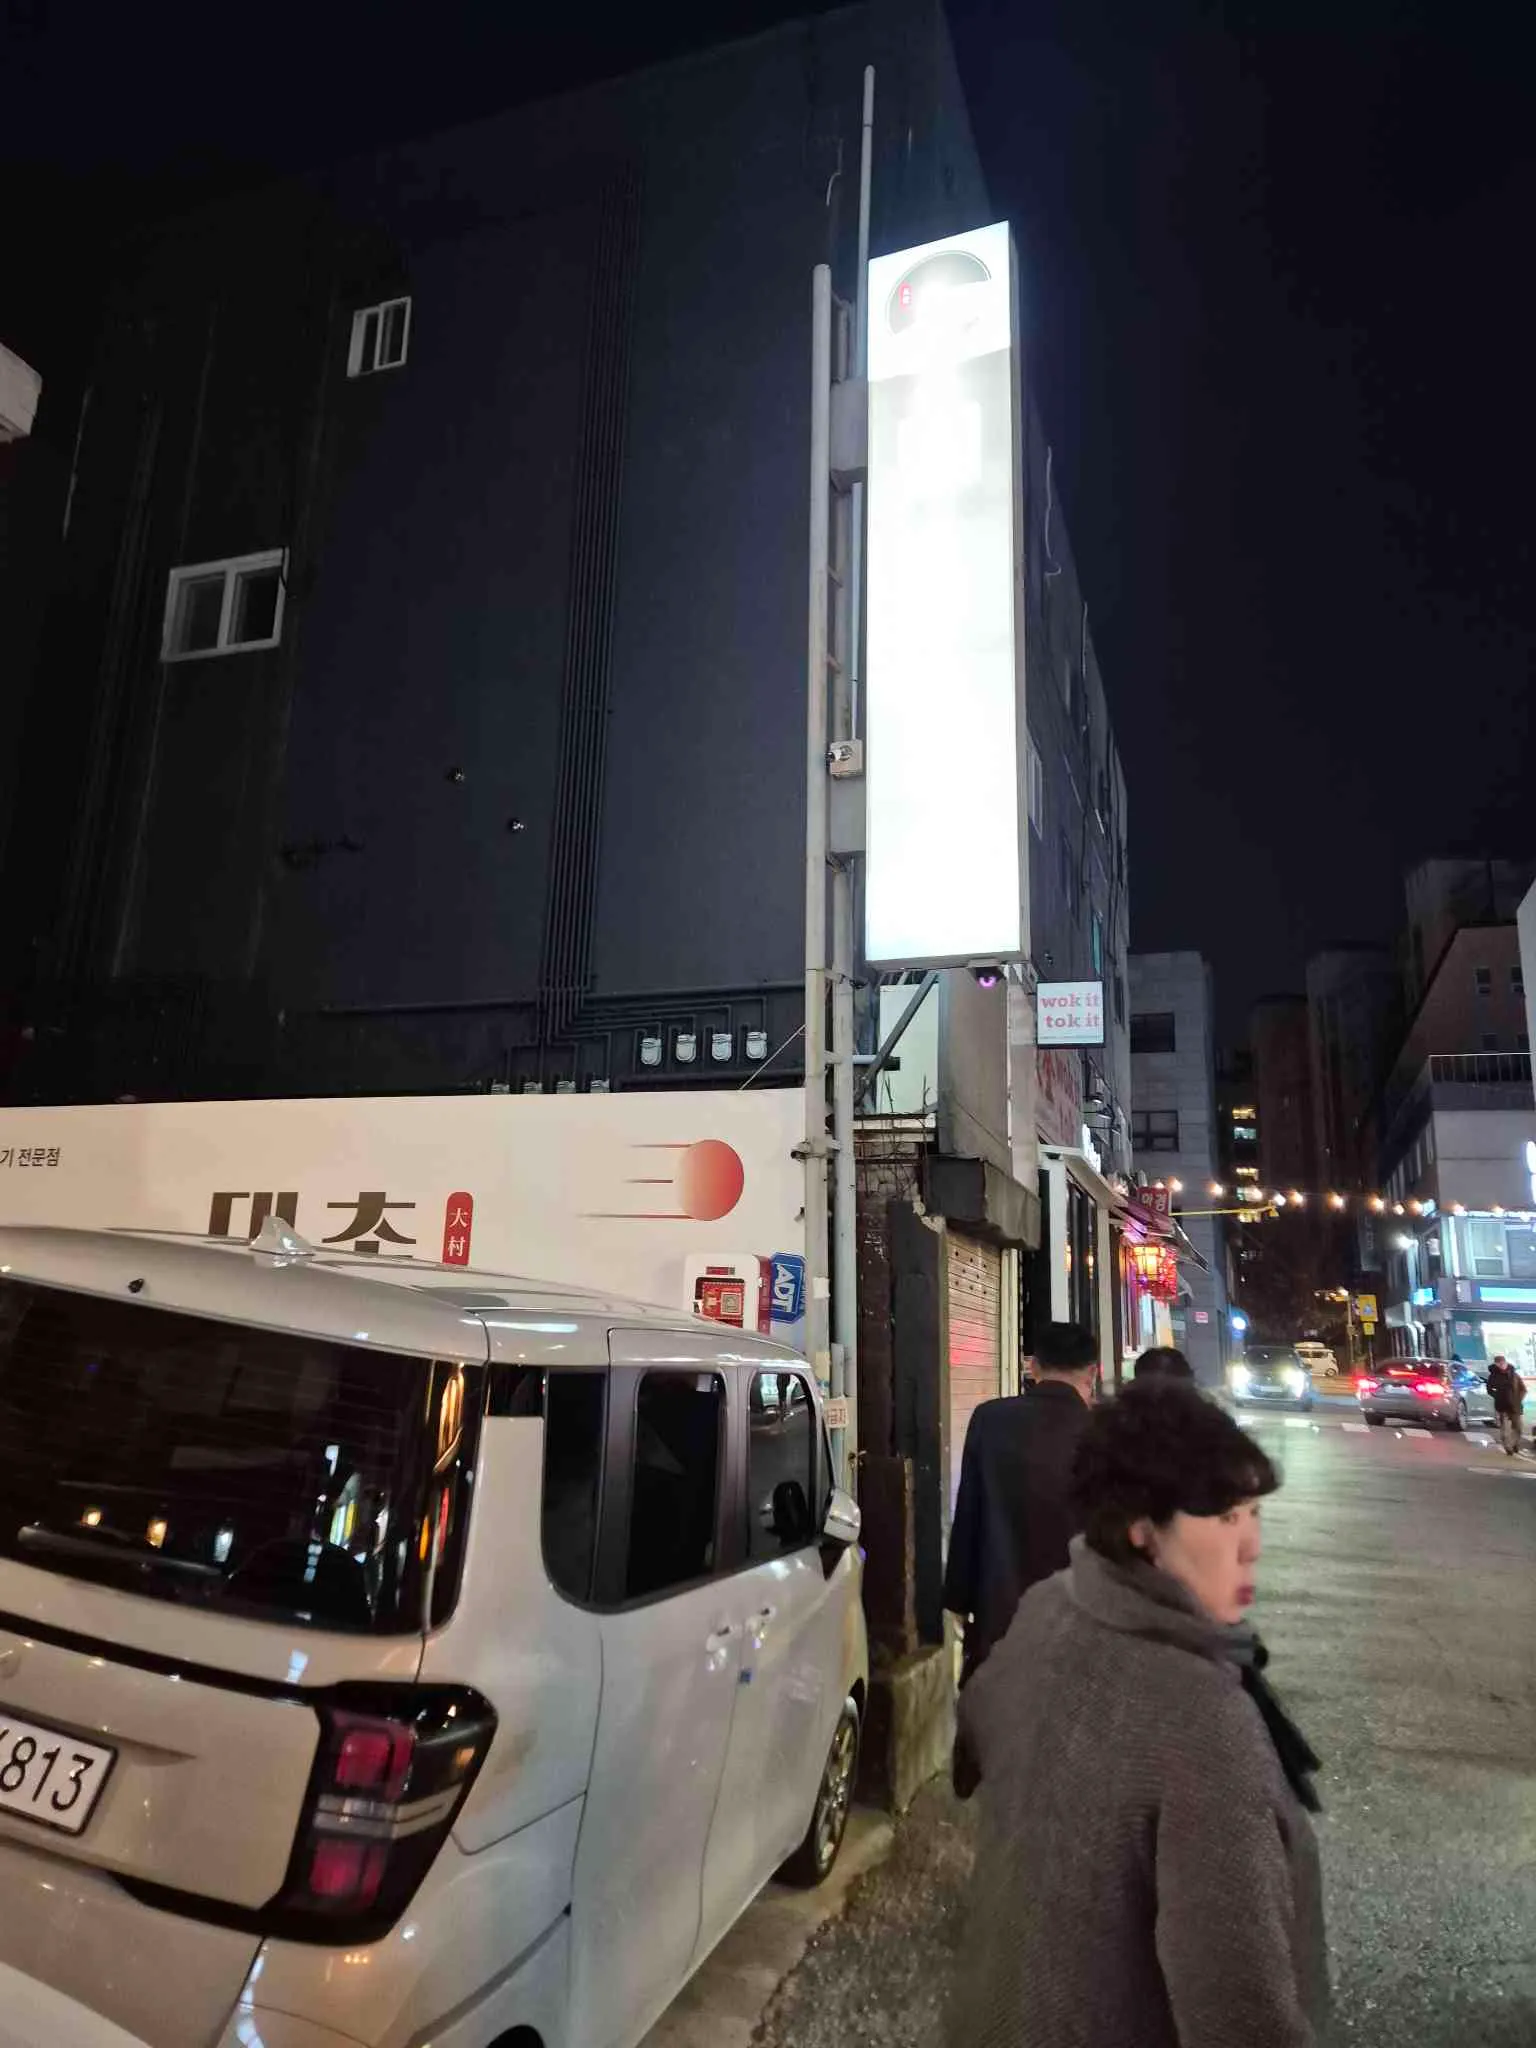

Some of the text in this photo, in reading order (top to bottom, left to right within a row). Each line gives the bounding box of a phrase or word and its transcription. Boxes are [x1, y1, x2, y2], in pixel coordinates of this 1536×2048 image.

[1040, 992, 1101, 1008] wok it
[1045, 1012, 1101, 1028] tok it
[18, 1147, 60, 1167] 전문점
[448, 1207, 469, 1257] 大村
[772, 1264, 796, 1313] ADT
[0, 1729, 94, 1810] 813
